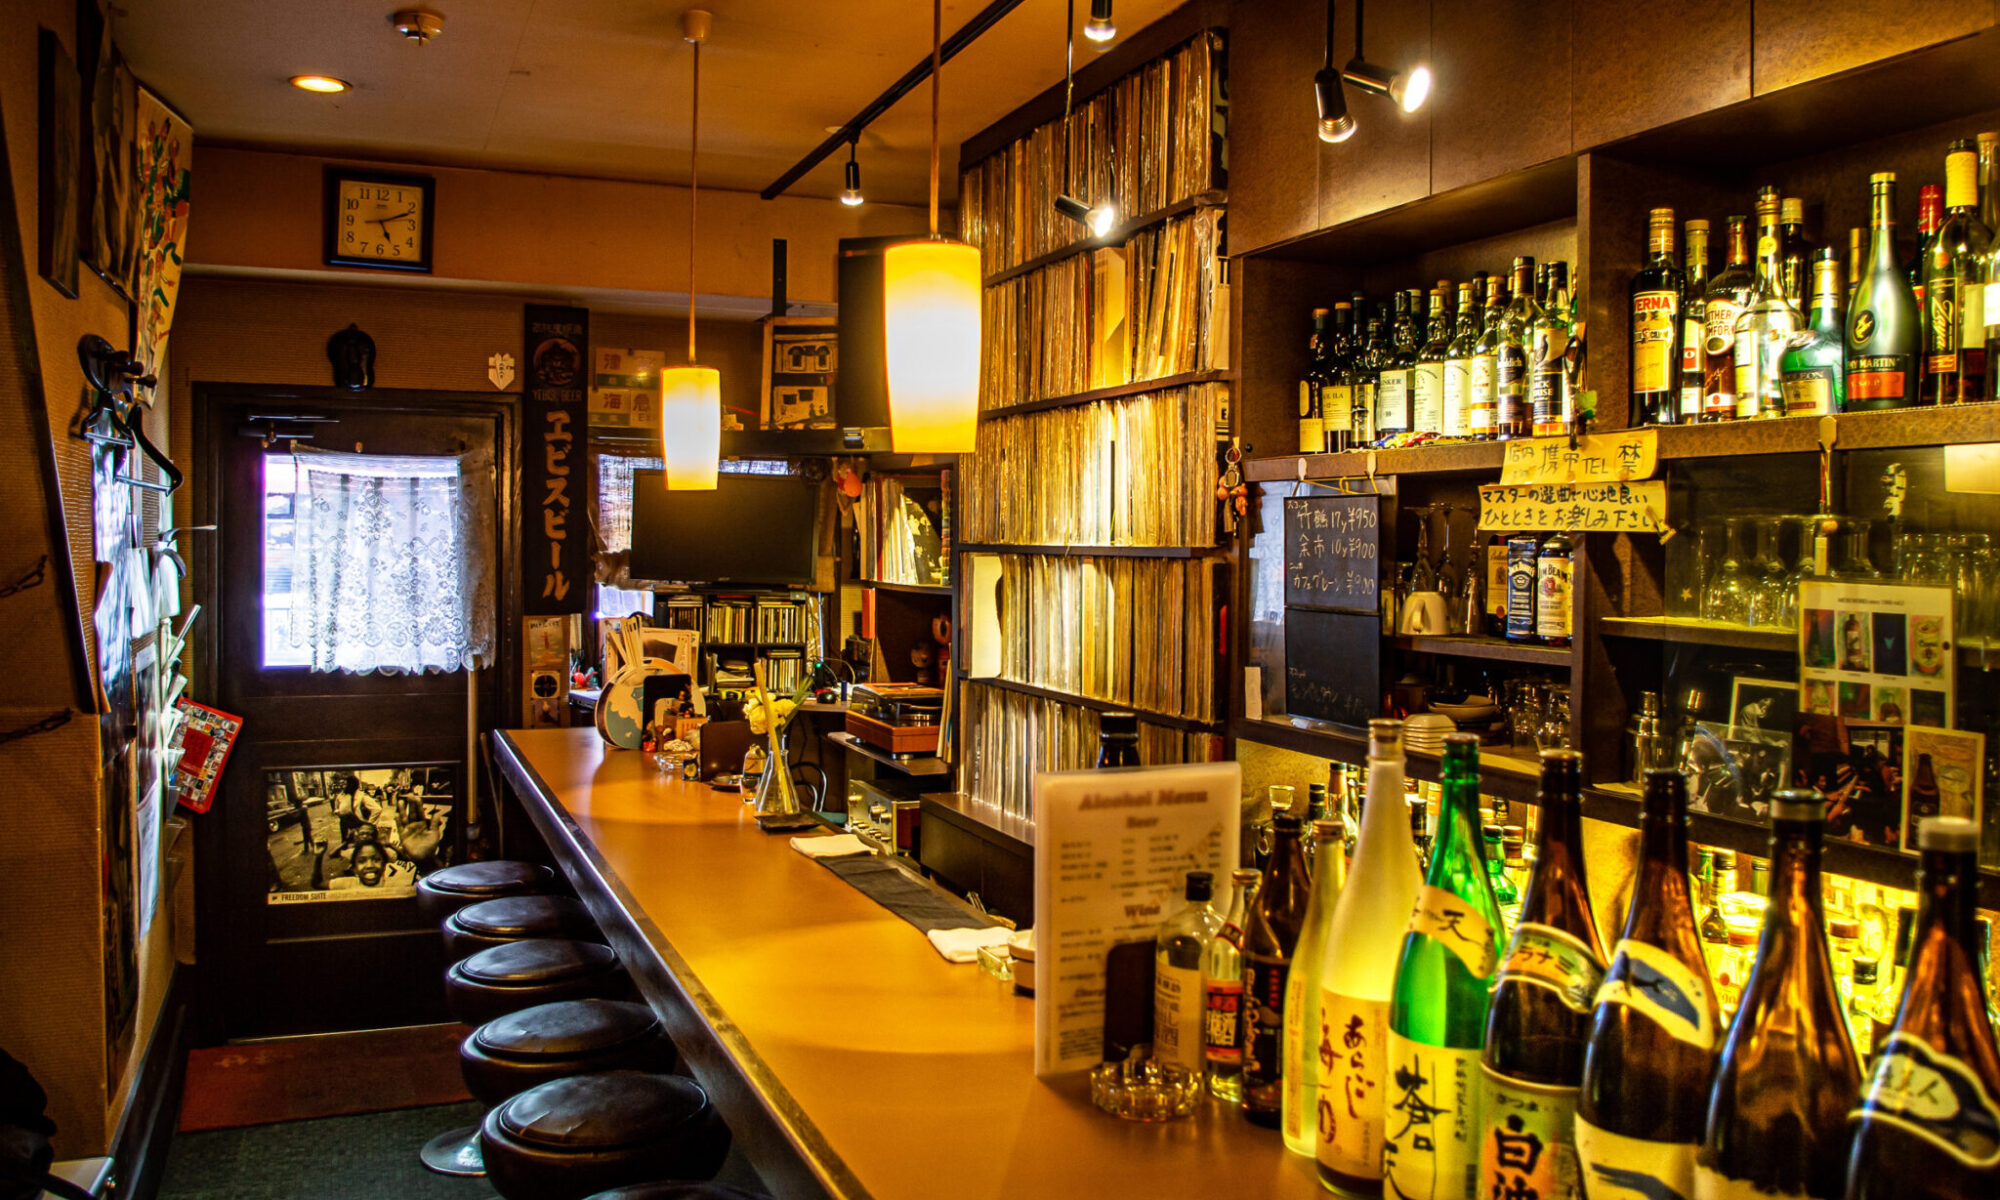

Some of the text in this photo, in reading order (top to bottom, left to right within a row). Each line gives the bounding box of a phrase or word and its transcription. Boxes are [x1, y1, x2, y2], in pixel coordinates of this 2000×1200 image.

[360, 188, 403, 203] 11 12 1
[346, 199, 359, 210] 10
[408, 202, 416, 214] 2
[346, 215, 354, 226] 9
[408, 219, 416, 231] 3
[346, 231, 354, 243] 8
[406, 236, 414, 248] 4
[360, 241, 401, 256] 7 6 5
[1859, 357, 1896, 369] MARTIN
